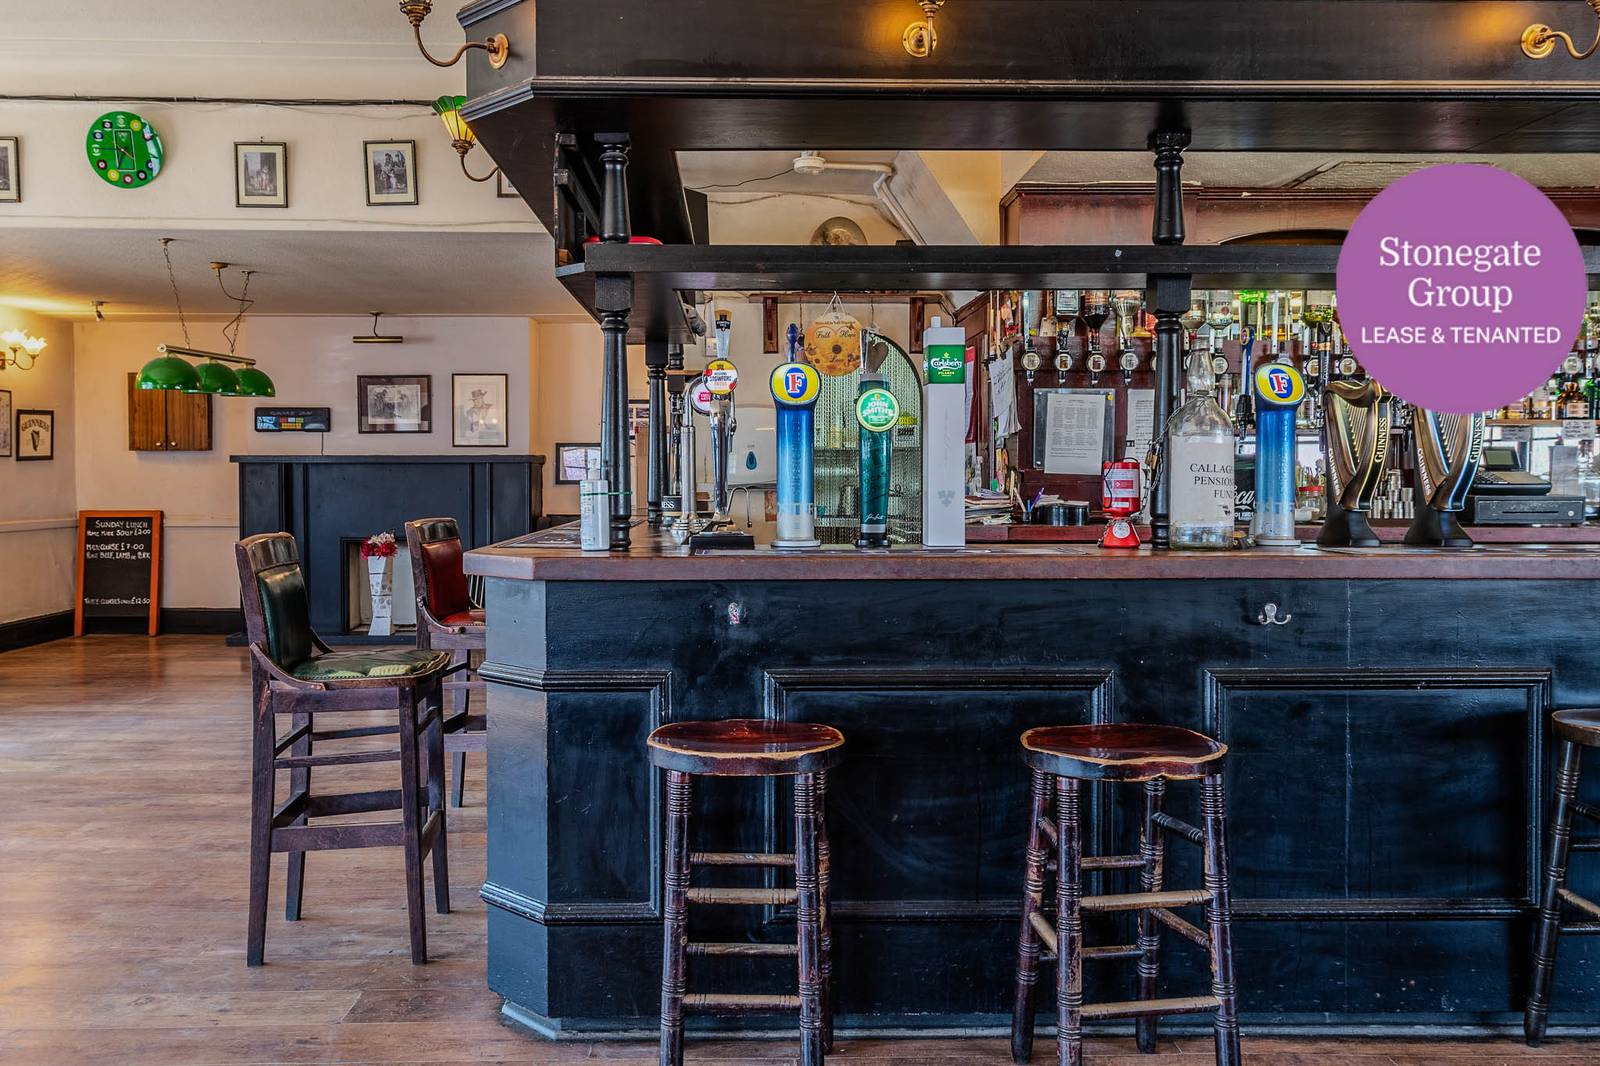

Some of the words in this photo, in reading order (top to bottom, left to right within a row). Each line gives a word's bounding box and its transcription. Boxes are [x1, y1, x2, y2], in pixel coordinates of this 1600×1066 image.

[930, 357, 963, 371] Carlsberg
[785, 372, 805, 393] F
[1269, 373, 1290, 394] F
[21, 418, 50, 433] GUINNESS
[1374, 416, 1387, 463] GUINNESS
[1470, 416, 1483, 463] GUINNESS
[1327, 447, 1342, 497] GUINNESS
[1416, 447, 1432, 497] GUINNESS
[95, 519, 124, 529] SUNDAY
[125, 520, 148, 529] LUNCH
